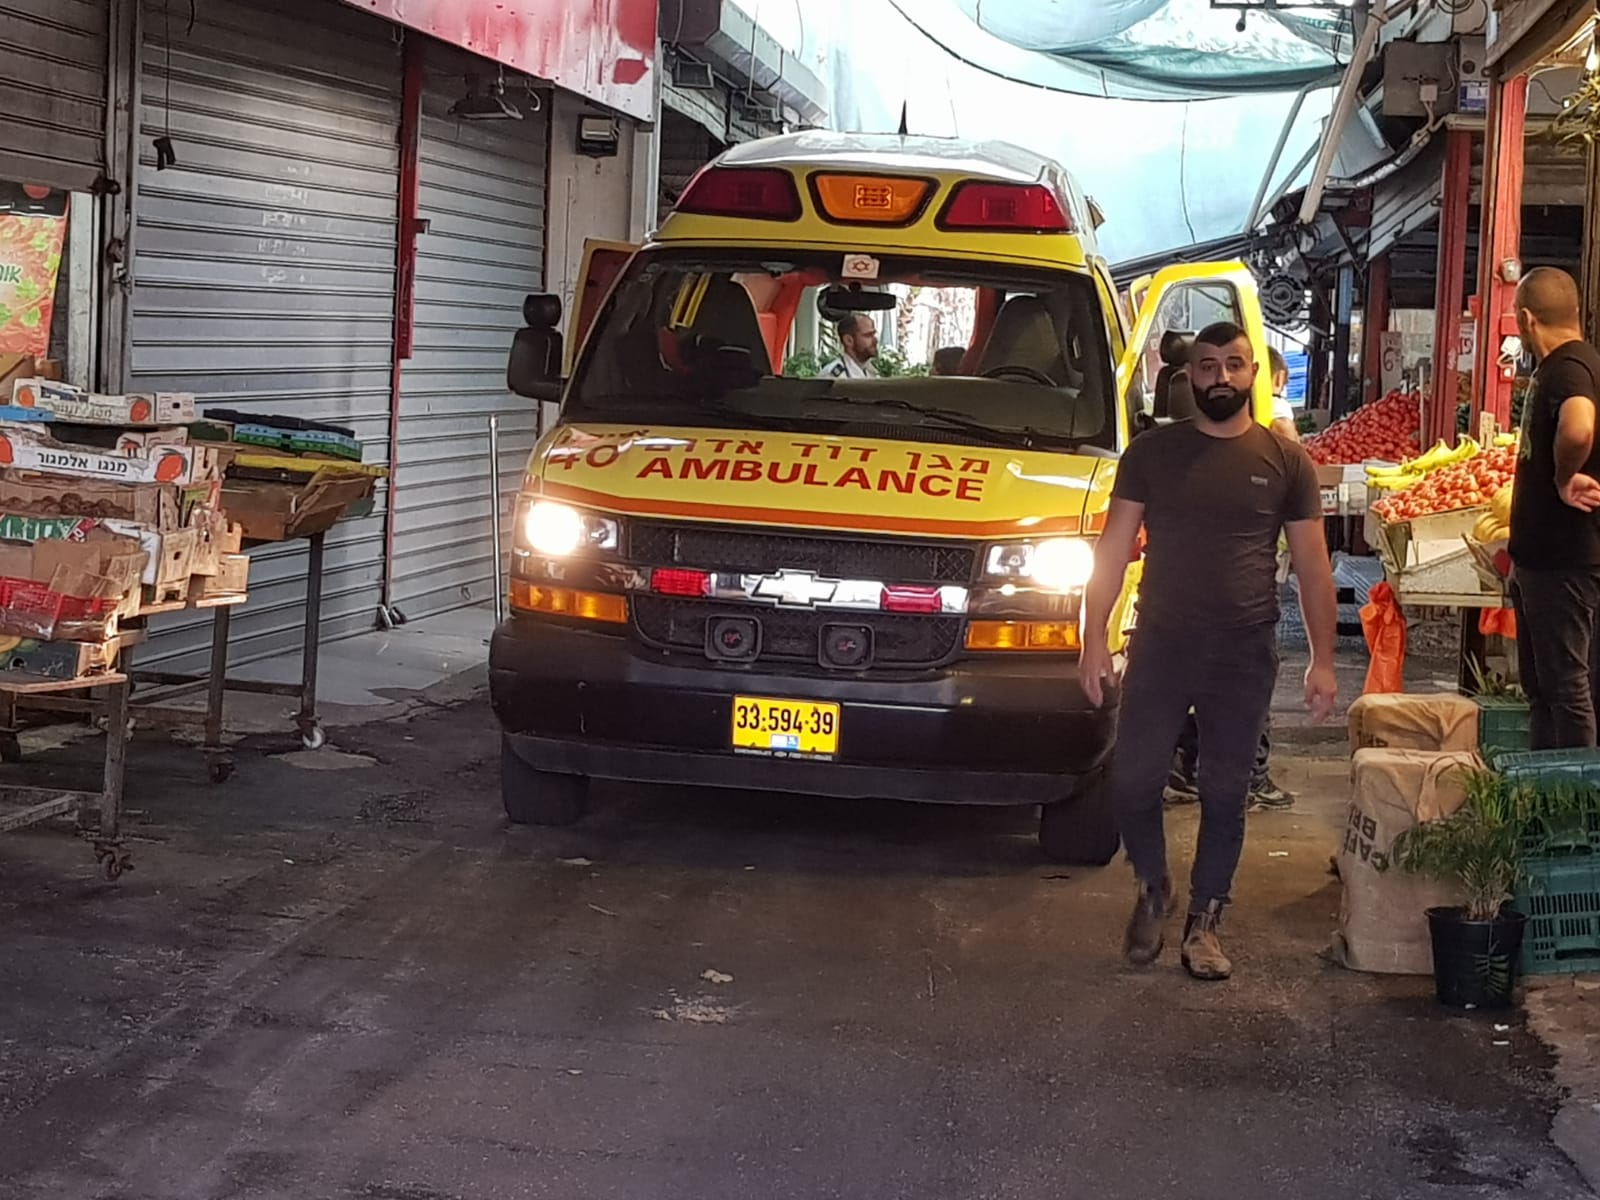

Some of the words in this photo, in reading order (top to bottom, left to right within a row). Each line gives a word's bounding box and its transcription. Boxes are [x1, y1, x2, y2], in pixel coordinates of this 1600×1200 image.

[37, 452, 88, 468] אלמגור
[791, 442, 878, 462] דוד
[97, 460, 128, 473] מנגו
[906, 451, 990, 474] מגן
[636, 457, 985, 502] AMBULANCE
